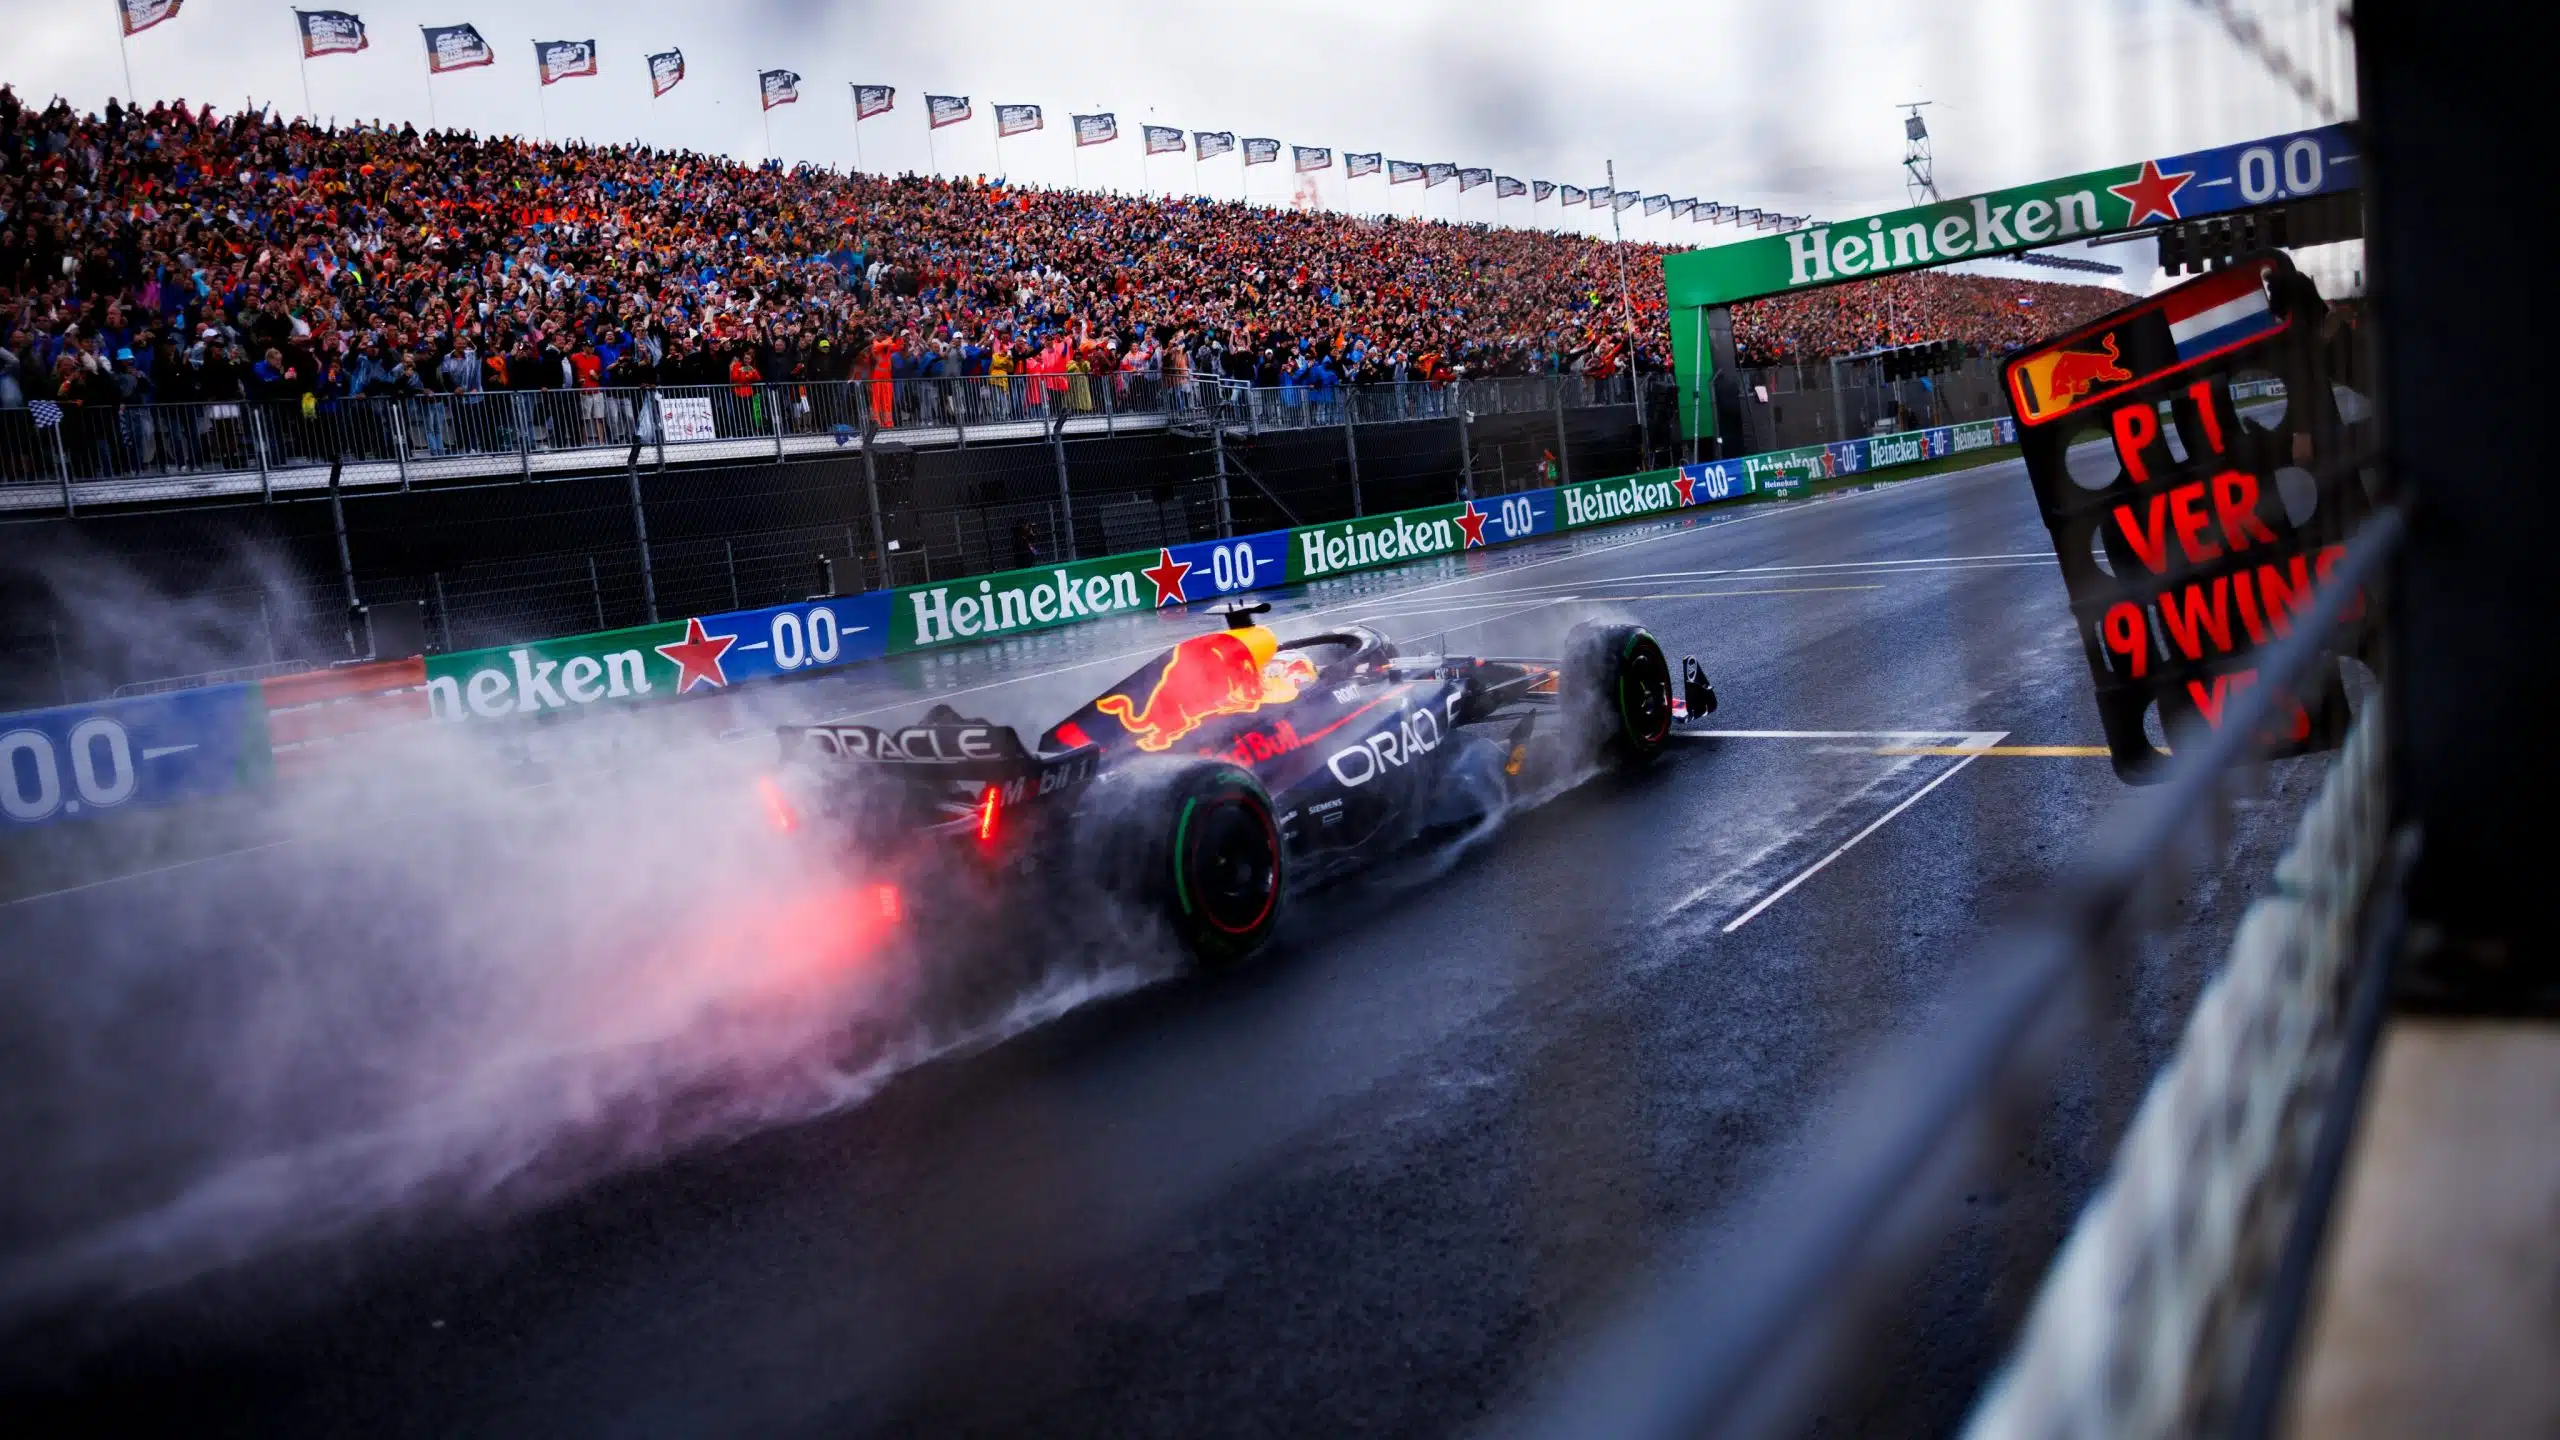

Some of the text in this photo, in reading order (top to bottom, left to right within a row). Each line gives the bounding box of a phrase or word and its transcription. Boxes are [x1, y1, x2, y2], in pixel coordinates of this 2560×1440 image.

[1788, 138, 2322, 286] Heineken 0.0
[1869, 436, 1920, 468] Heineken
[1563, 464, 1730, 526] Heineken 0.0
[2112, 470, 2279, 576] VER
[1299, 496, 1534, 577] Heineken 0.0
[909, 541, 1255, 646] Heineken 0.0
[770, 606, 840, 670] 0.0
[0, 729, 137, 822] 0.0
[1308, 798, 1343, 815] SIEMENS
